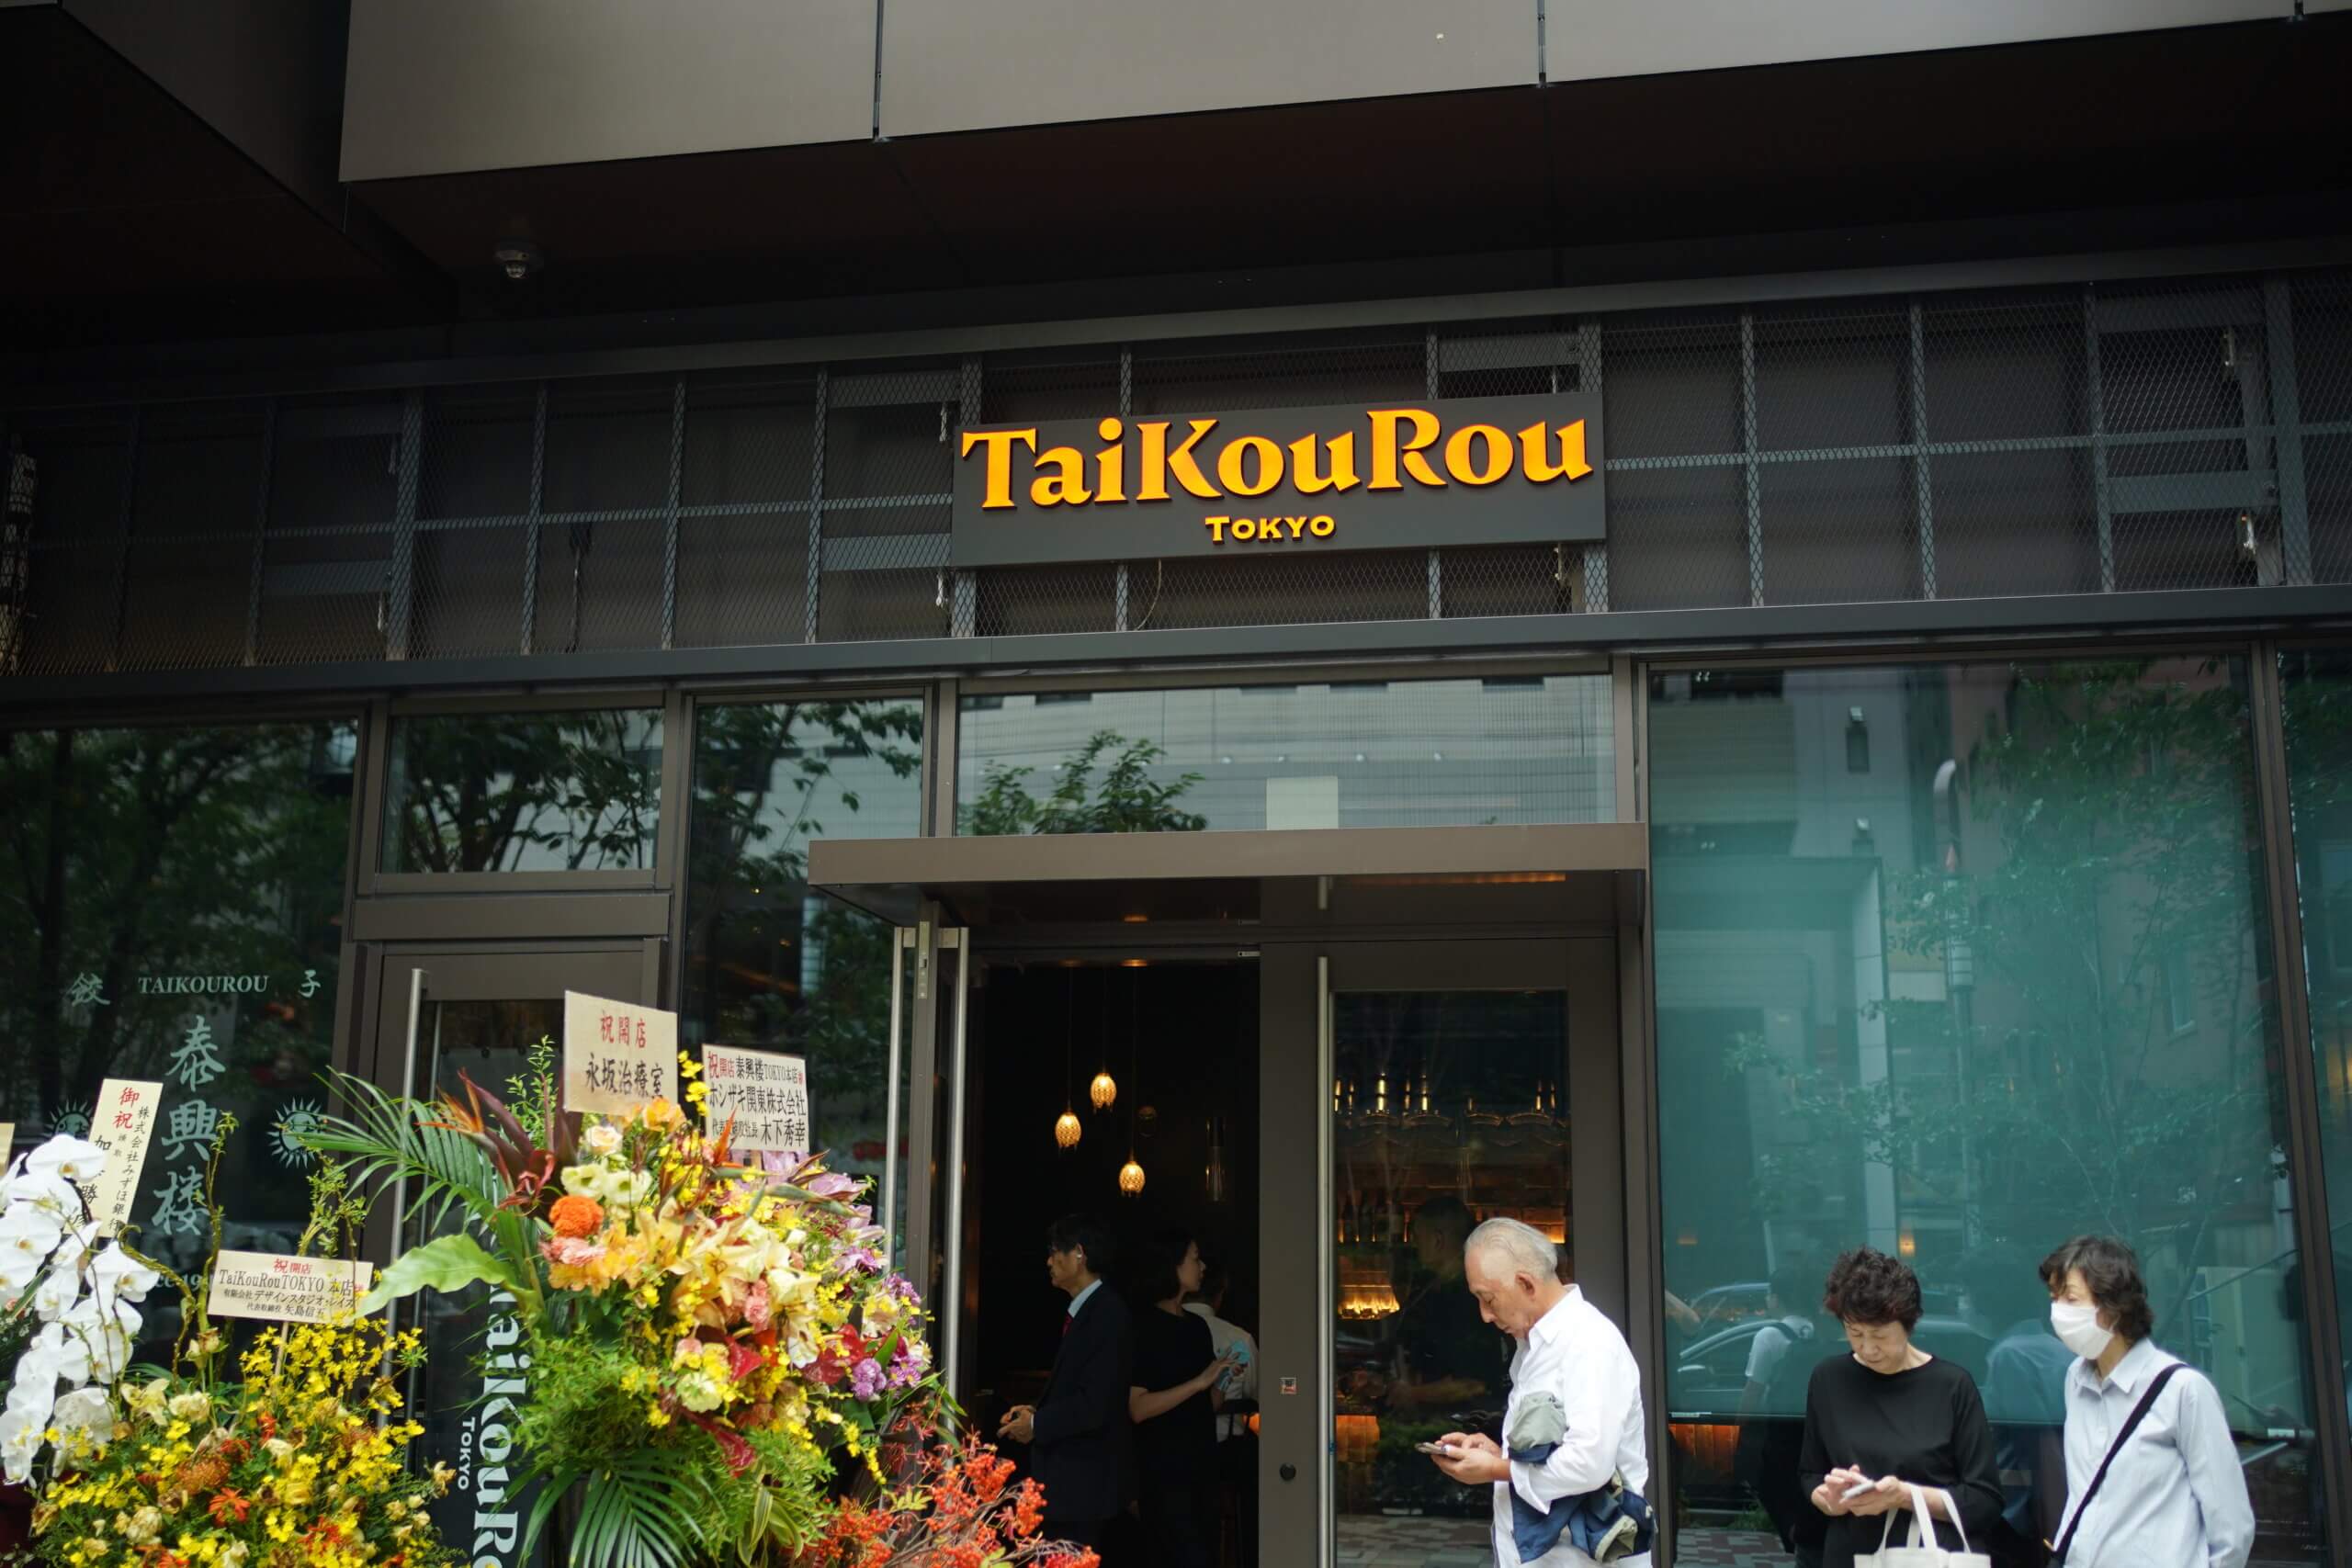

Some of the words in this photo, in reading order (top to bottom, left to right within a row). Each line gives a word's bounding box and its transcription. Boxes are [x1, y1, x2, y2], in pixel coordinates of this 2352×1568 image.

[962, 408, 1594, 508] TaiKouRou
[1204, 514, 1336, 544] TOKYO
[139, 975, 269, 994] TAIKOUROU
[299, 969, 322, 998] 子
[600, 1010, 647, 1048] 祝開店
[585, 1052, 664, 1100] 永坂治療室
[112, 1087, 141, 1130] 御祝
[709, 1082, 807, 1116] ホシザキ関東株式会社
[761, 1116, 806, 1147] 木下秀幸
[457, 1416, 476, 1492] TOKYO
